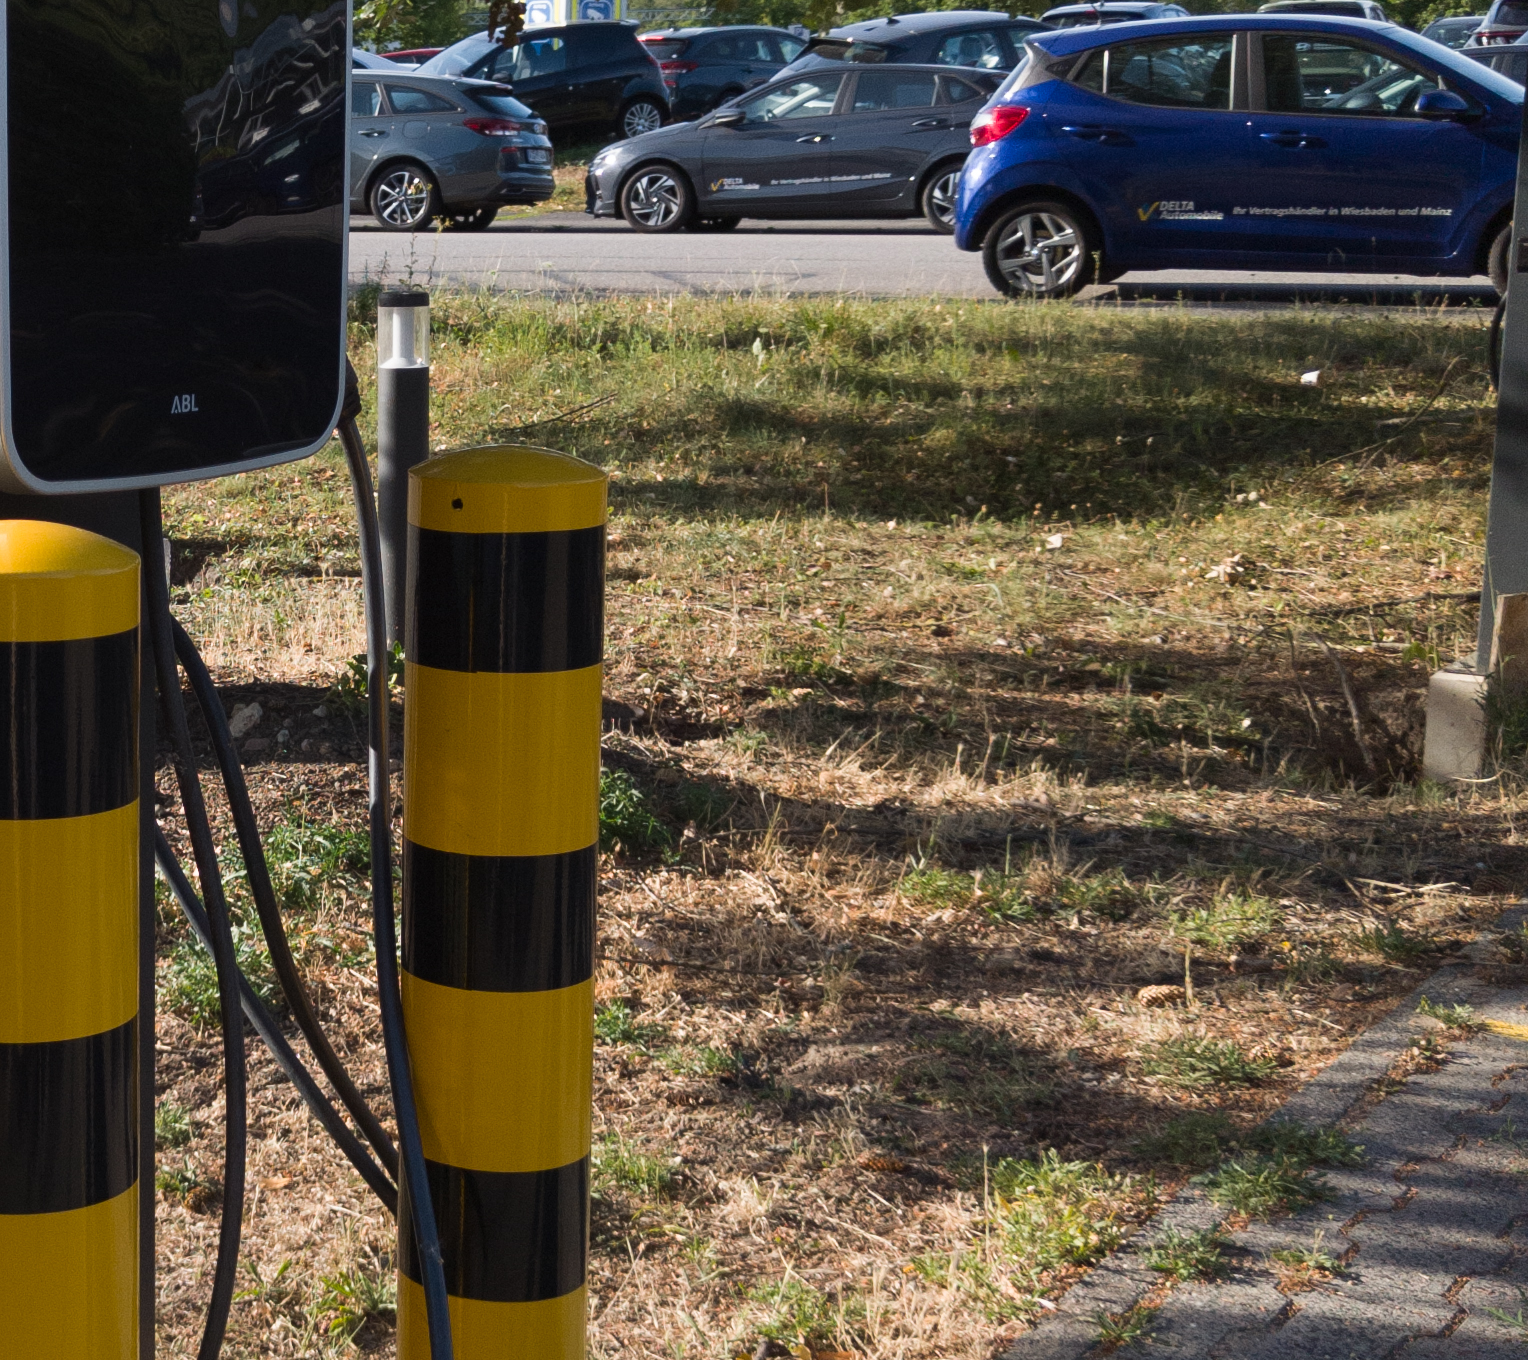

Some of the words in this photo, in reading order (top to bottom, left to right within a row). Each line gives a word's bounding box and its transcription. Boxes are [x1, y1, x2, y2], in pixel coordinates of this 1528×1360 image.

[1159, 201, 1195, 211] DELTA
[1159, 210, 1224, 220] Automobile
[1233, 206, 1247, 215] Ihr
[1249, 206, 1326, 217] Vertragshändler
[1328, 207, 1339, 215] in
[1340, 207, 1396, 216] Wiesbaden
[1398, 207, 1419, 216] und
[1420, 207, 1453, 216] Mainz
[171, 394, 199, 414] ABL
